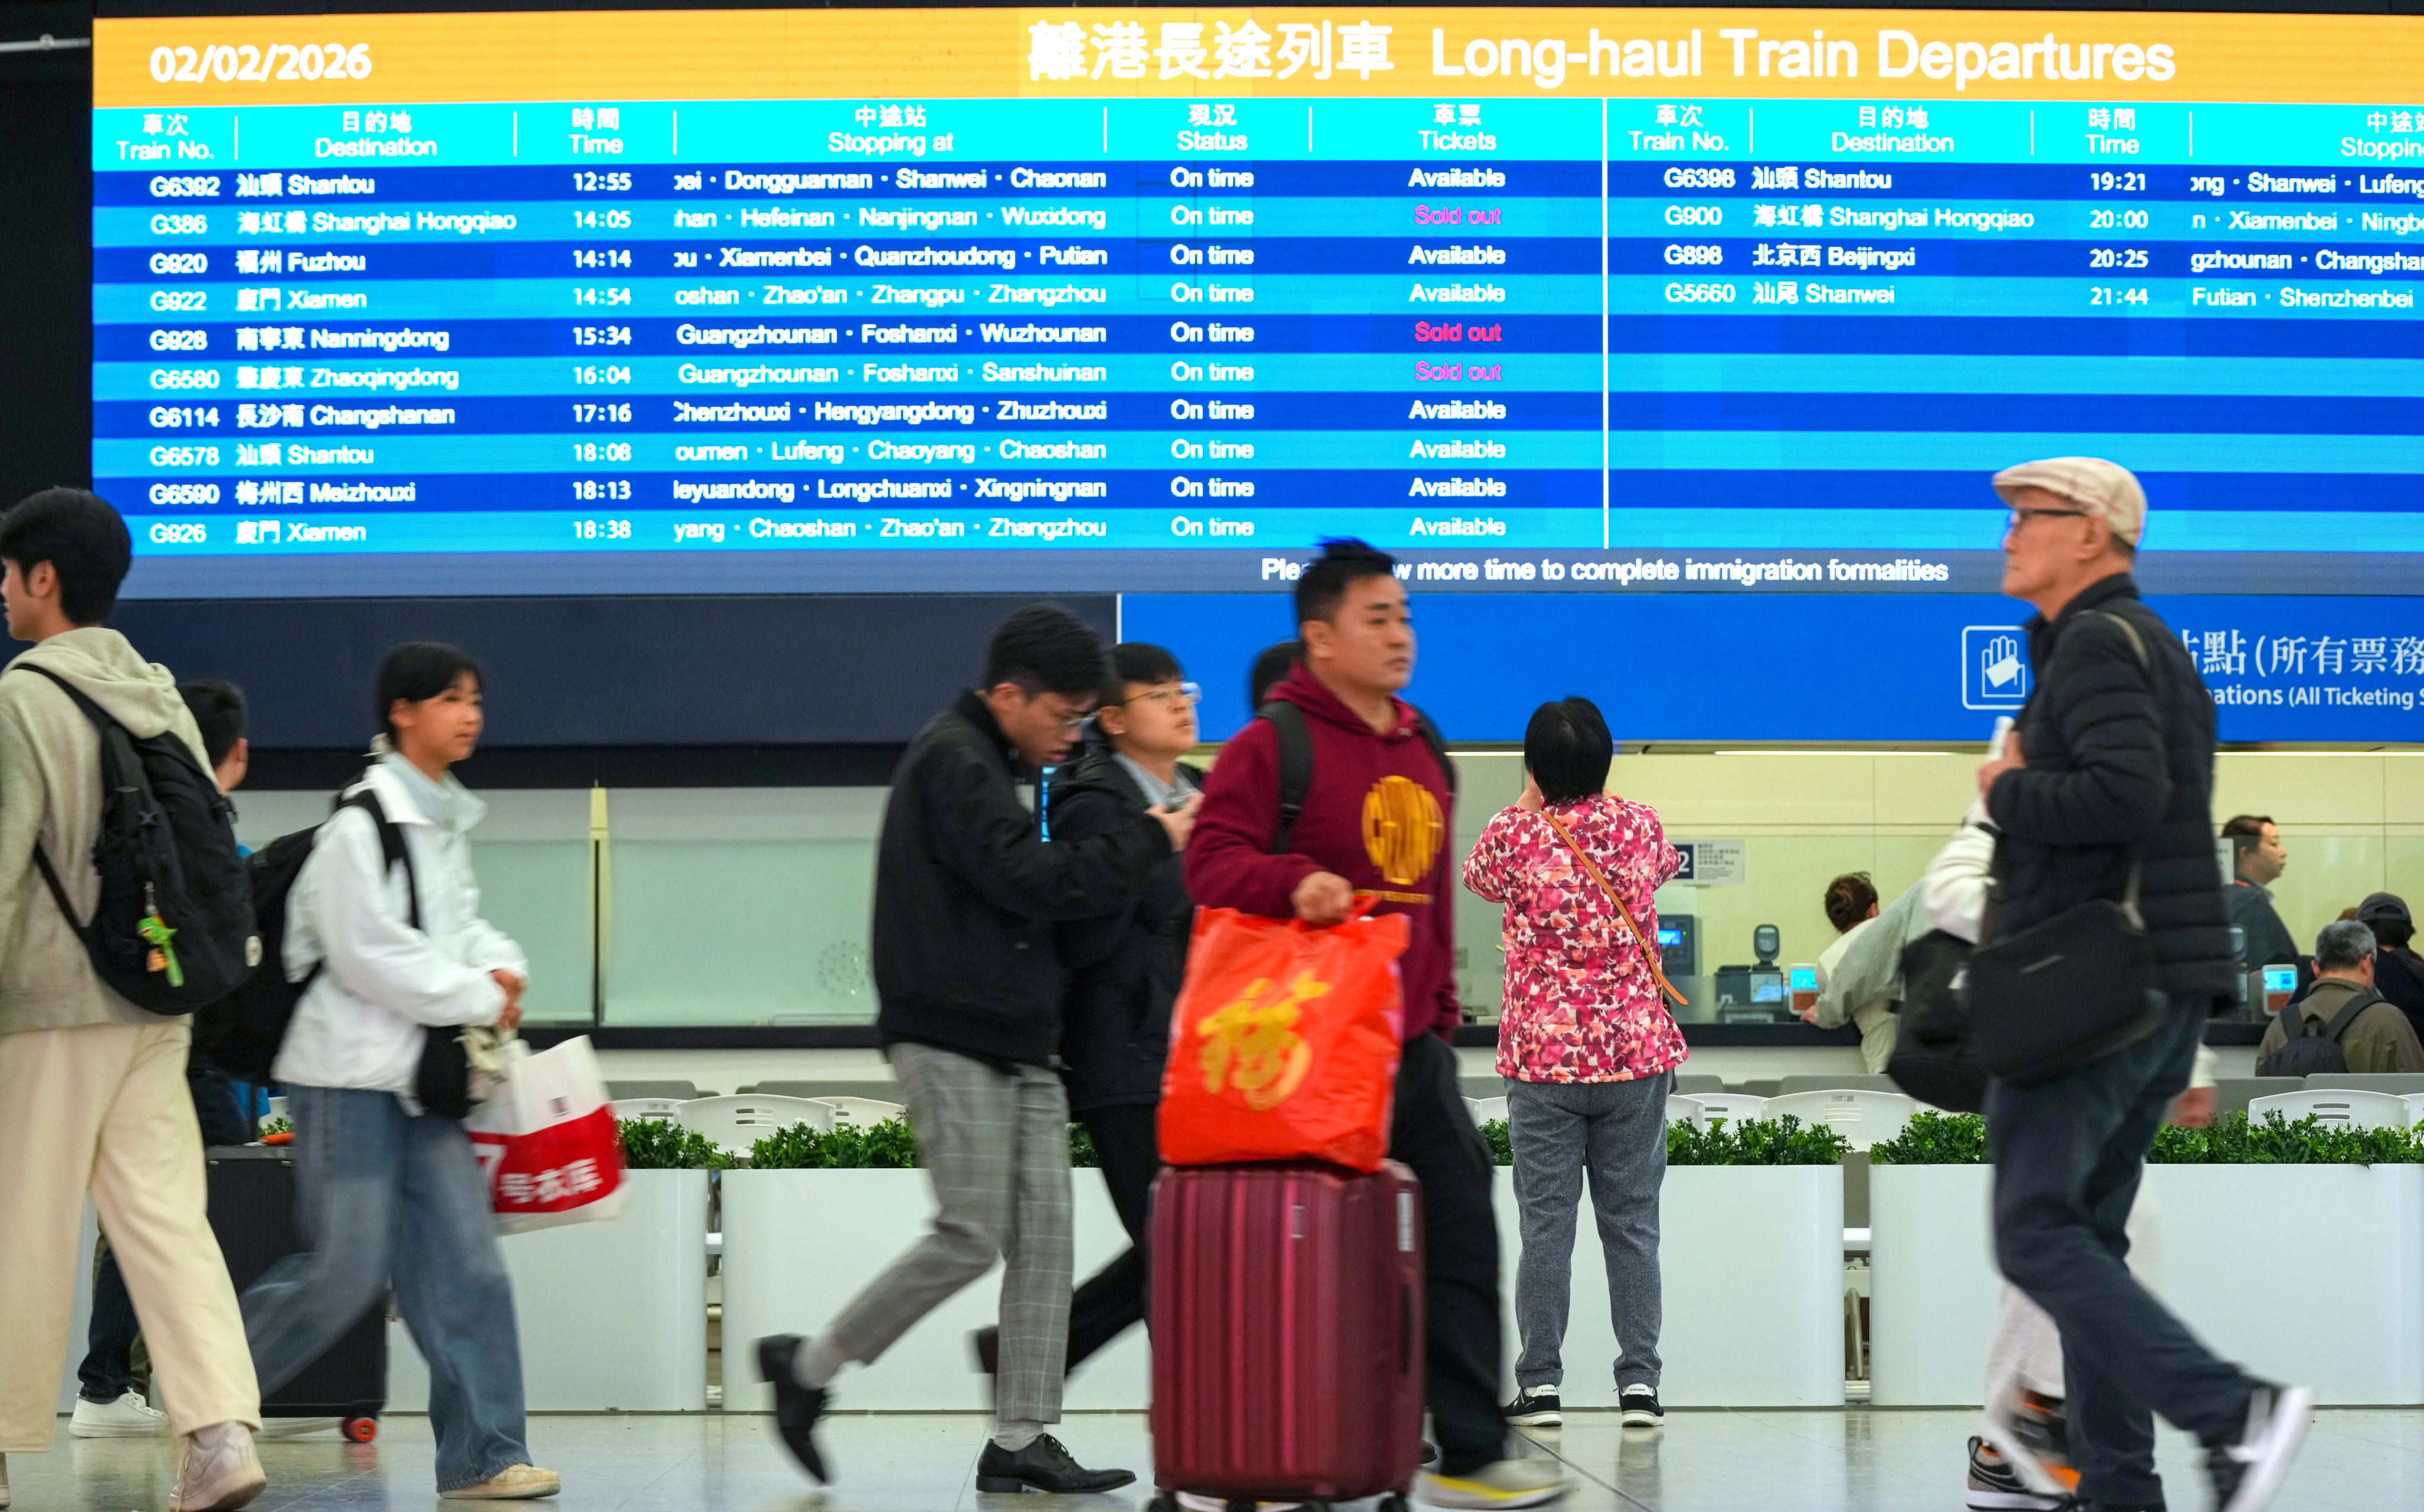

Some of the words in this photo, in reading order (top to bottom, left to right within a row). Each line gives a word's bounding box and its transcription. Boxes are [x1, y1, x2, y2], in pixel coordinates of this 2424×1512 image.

[150, 44, 371, 82] 02/02/2026
[1028, 20, 1394, 80] 離港長途列車
[1433, 28, 1701, 88] Long-haul
[1720, 29, 1858, 78] Train
[1879, 30, 2175, 91] Departures
[143, 114, 188, 136] 車次
[343, 110, 411, 133] 目的地
[572, 108, 619, 130] 時間
[855, 105, 926, 127] 中途站
[1189, 104, 1237, 127] 現況
[1434, 104, 1480, 126] 車票
[1656, 104, 1702, 127] 車次
[1860, 105, 1929, 128] 目的地
[2089, 108, 2135, 130] 時間
[117, 141, 170, 160] Train
[179, 141, 214, 159] No.
[316, 137, 437, 157] Destination
[569, 134, 623, 153] Time
[828, 133, 926, 157] Stopping
[933, 133, 953, 151] at
[1177, 131, 1247, 150] Status
[1418, 131, 1496, 150] Tickets
[1629, 131, 1684, 150] Train
[1693, 131, 1728, 150] No.
[1832, 133, 1953, 151] Destination
[2085, 134, 2139, 154] Time
[151, 176, 220, 196] G6392
[288, 175, 374, 194] Shantou
[574, 172, 631, 191] 12:55
[726, 170, 872, 193] Dongguannan
[896, 168, 986, 188] Shanwei
[1011, 167, 1106, 187] Chaonan
[1171, 167, 1202, 187] On
[1208, 169, 1254, 186] time
[1409, 168, 1505, 186] Available
[1665, 167, 1735, 187] G6398
[1805, 168, 1891, 188] Shantou
[2091, 172, 2145, 190] 19:21
[2248, 172, 2335, 192] Shanwei
[152, 214, 207, 234] G386
[314, 212, 410, 235] Shanghai
[418, 212, 516, 234] Hongqiao
[575, 210, 630, 228] 14:05
[742, 207, 834, 227] Hefeinan
[860, 208, 977, 230] Nanjingnan
[1002, 207, 1106, 229] Wuxidong
[1415, 205, 1461, 224] Sold
[1468, 208, 1501, 224] out
[1666, 205, 1722, 225] G900
[1830, 207, 1927, 230] Shanghai
[1936, 208, 2034, 231] Hongqiao
[2091, 210, 2148, 227] 20:00
[2229, 211, 2337, 230] Xiamenbei
[150, 253, 207, 273] G920
[237, 250, 281, 273] 福州
[289, 252, 365, 271] Fuzhou
[574, 250, 631, 267] 14:14
[720, 247, 831, 266] Xiamenbei
[855, 246, 1015, 269] Quanzhoudong
[1041, 246, 1107, 264] Putian
[1171, 244, 1202, 264] On
[1208, 246, 1254, 264] time
[1409, 246, 1505, 264] Available
[1665, 244, 1723, 264] G898
[1753, 243, 1821, 266] 北京西
[1829, 247, 1914, 270] Beijingxi
[2091, 249, 2148, 267] 20:25
[151, 291, 206, 311] G922
[288, 291, 366, 308] Xiamen
[575, 288, 631, 305] 14:54
[764, 286, 847, 304] Zhao'an
[872, 285, 964, 307] Zhangpu
[989, 284, 1106, 307] Zhangzhou
[1410, 284, 1505, 302] Available
[1666, 283, 1735, 302] G5660
[1753, 282, 1798, 304] 汕尾
[1806, 283, 1894, 303] Shanwei
[2091, 287, 2148, 304] 21:44
[2194, 288, 2255, 305] Futian
[2281, 287, 2413, 307] Shenzhenbei
[150, 330, 207, 350] G928
[311, 328, 449, 351] Nanningdong
[574, 326, 631, 344] 15:34
[677, 324, 837, 348] Guangzhounan
[862, 324, 957, 343] Foshanxi
[980, 324, 1106, 342] Wuzhounan
[1171, 322, 1203, 341] On
[1209, 323, 1254, 341] time
[1415, 321, 1462, 341] Sold
[1469, 324, 1501, 341] out
[151, 369, 219, 389] G6580
[311, 368, 458, 390] Zhaoqingdong
[575, 366, 630, 383] 16:04
[679, 363, 838, 387] Guangzhounan
[864, 364, 958, 382] Foshanxi
[983, 362, 1106, 381] Sanshuinan
[1416, 361, 1461, 381] Sold
[1469, 364, 1501, 381] out
[150, 407, 218, 427] G6114
[237, 404, 304, 427] 長沙南
[311, 405, 455, 428] Changshanan
[574, 404, 631, 422] 17:16
[816, 401, 974, 424] Hengyangdong
[997, 401, 1106, 420] Zhuzhouxi
[1171, 399, 1203, 419] On
[1209, 401, 1254, 419] time
[150, 446, 219, 466] G6578
[288, 444, 373, 464] Shantou
[575, 443, 631, 461] 18:08
[772, 440, 844, 463] Lufeng
[868, 440, 974, 463] Chaoyang
[1000, 439, 1106, 459] Chaoshan
[1410, 440, 1506, 457] Available
[150, 483, 220, 504] G6590
[236, 481, 304, 504] 梅州西
[311, 482, 415, 502] Meizhouxi
[574, 481, 631, 499] 18:13
[819, 479, 951, 502] Longchuanxi
[975, 478, 1106, 501] Xingningnan
[150, 523, 206, 543] G926
[288, 523, 366, 541] Xiamen
[575, 520, 631, 539] 18:38
[675, 524, 724, 542] yang
[750, 518, 855, 537] Chaoshan
[881, 518, 964, 536] Zhao'an
[989, 518, 1106, 540] Zhangzhou
[1263, 559, 1300, 579] Ple
[1418, 563, 1478, 579] more
[1485, 559, 1535, 579] time
[1541, 560, 1565, 579] to
[1572, 559, 1679, 585] complete
[1686, 559, 1821, 585] immigration
[1828, 559, 1948, 580] formalities
[2288, 686, 2320, 708] (All
[2324, 686, 2414, 711] Ticketing
